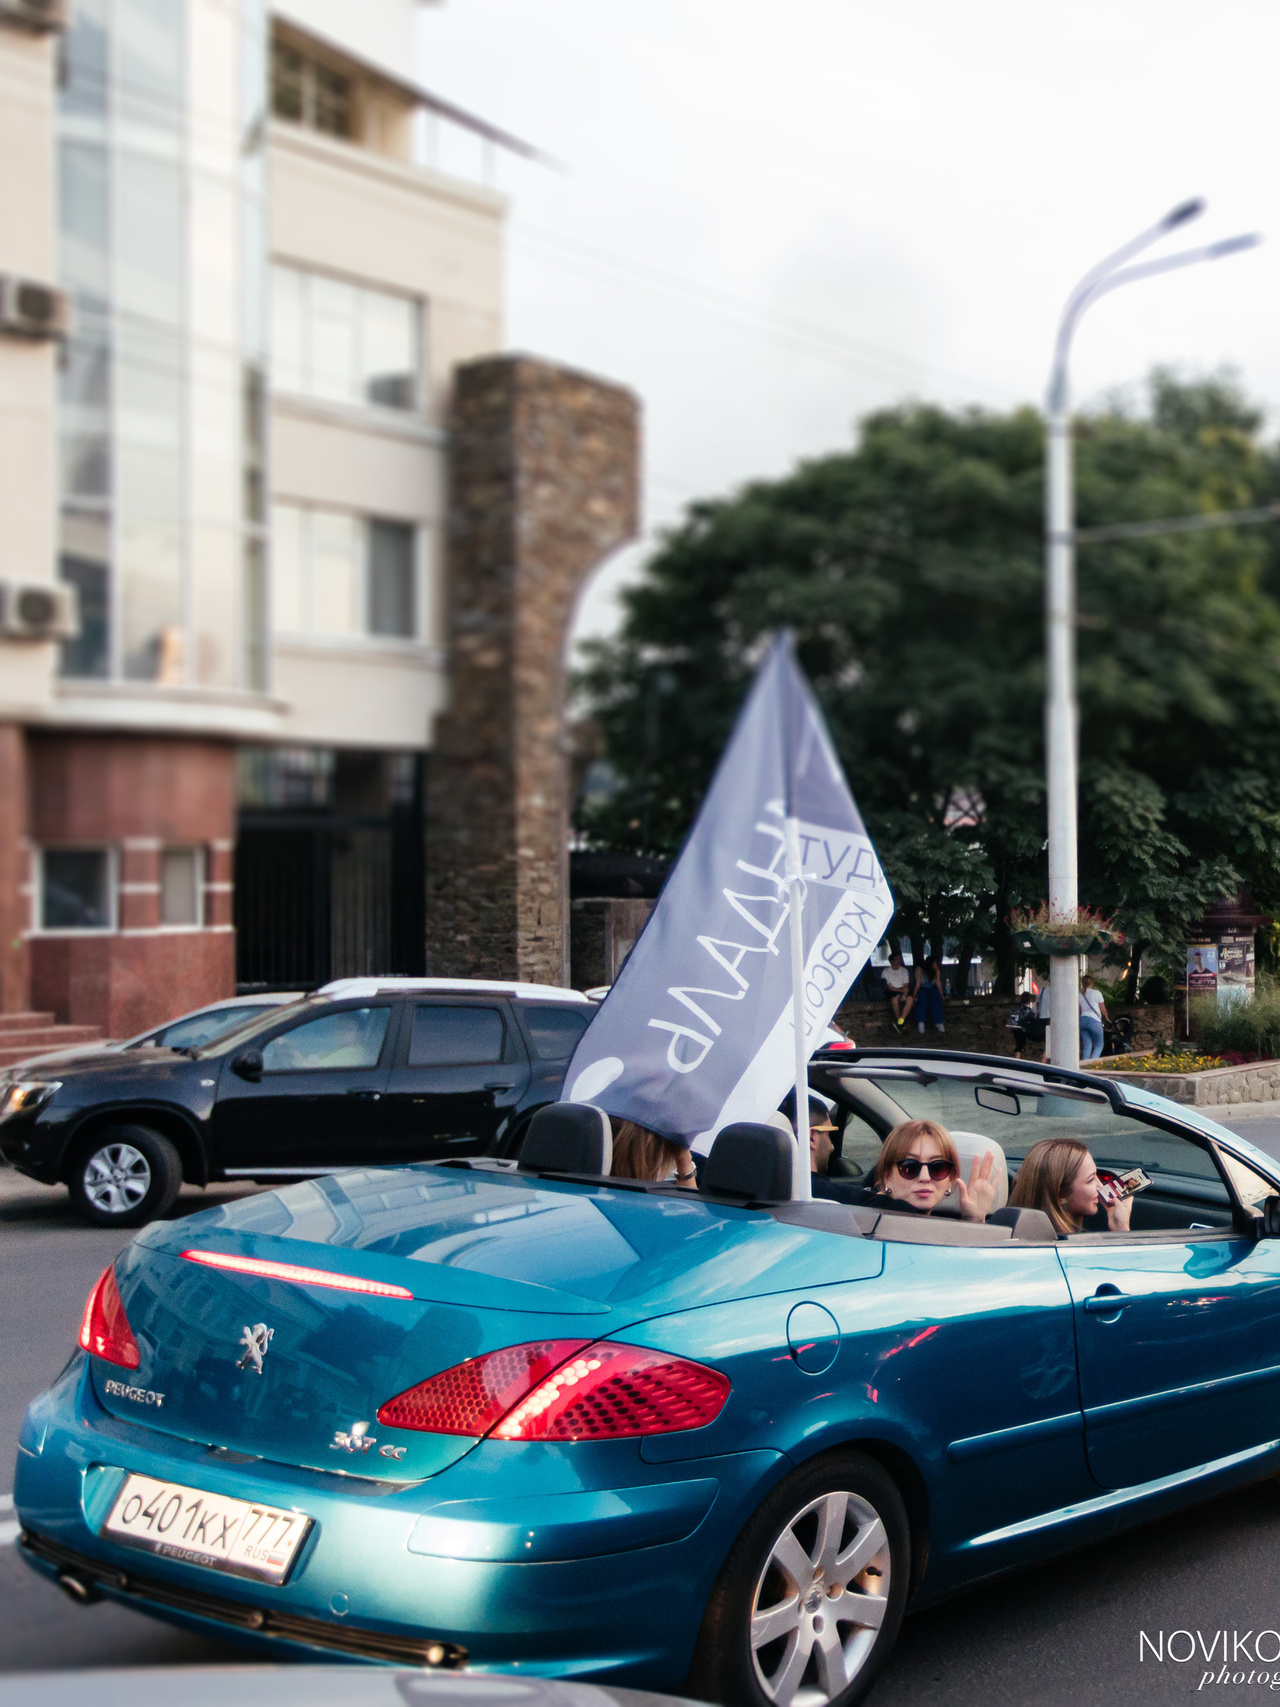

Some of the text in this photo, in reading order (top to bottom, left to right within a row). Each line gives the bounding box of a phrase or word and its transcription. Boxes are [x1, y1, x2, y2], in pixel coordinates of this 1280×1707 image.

[105, 1379, 165, 1407] PEUGEOT
[242, 1508, 297, 1549] 777
[162, 1545, 217, 1568] PEUGEOT
[244, 1545, 268, 1562] RUS
